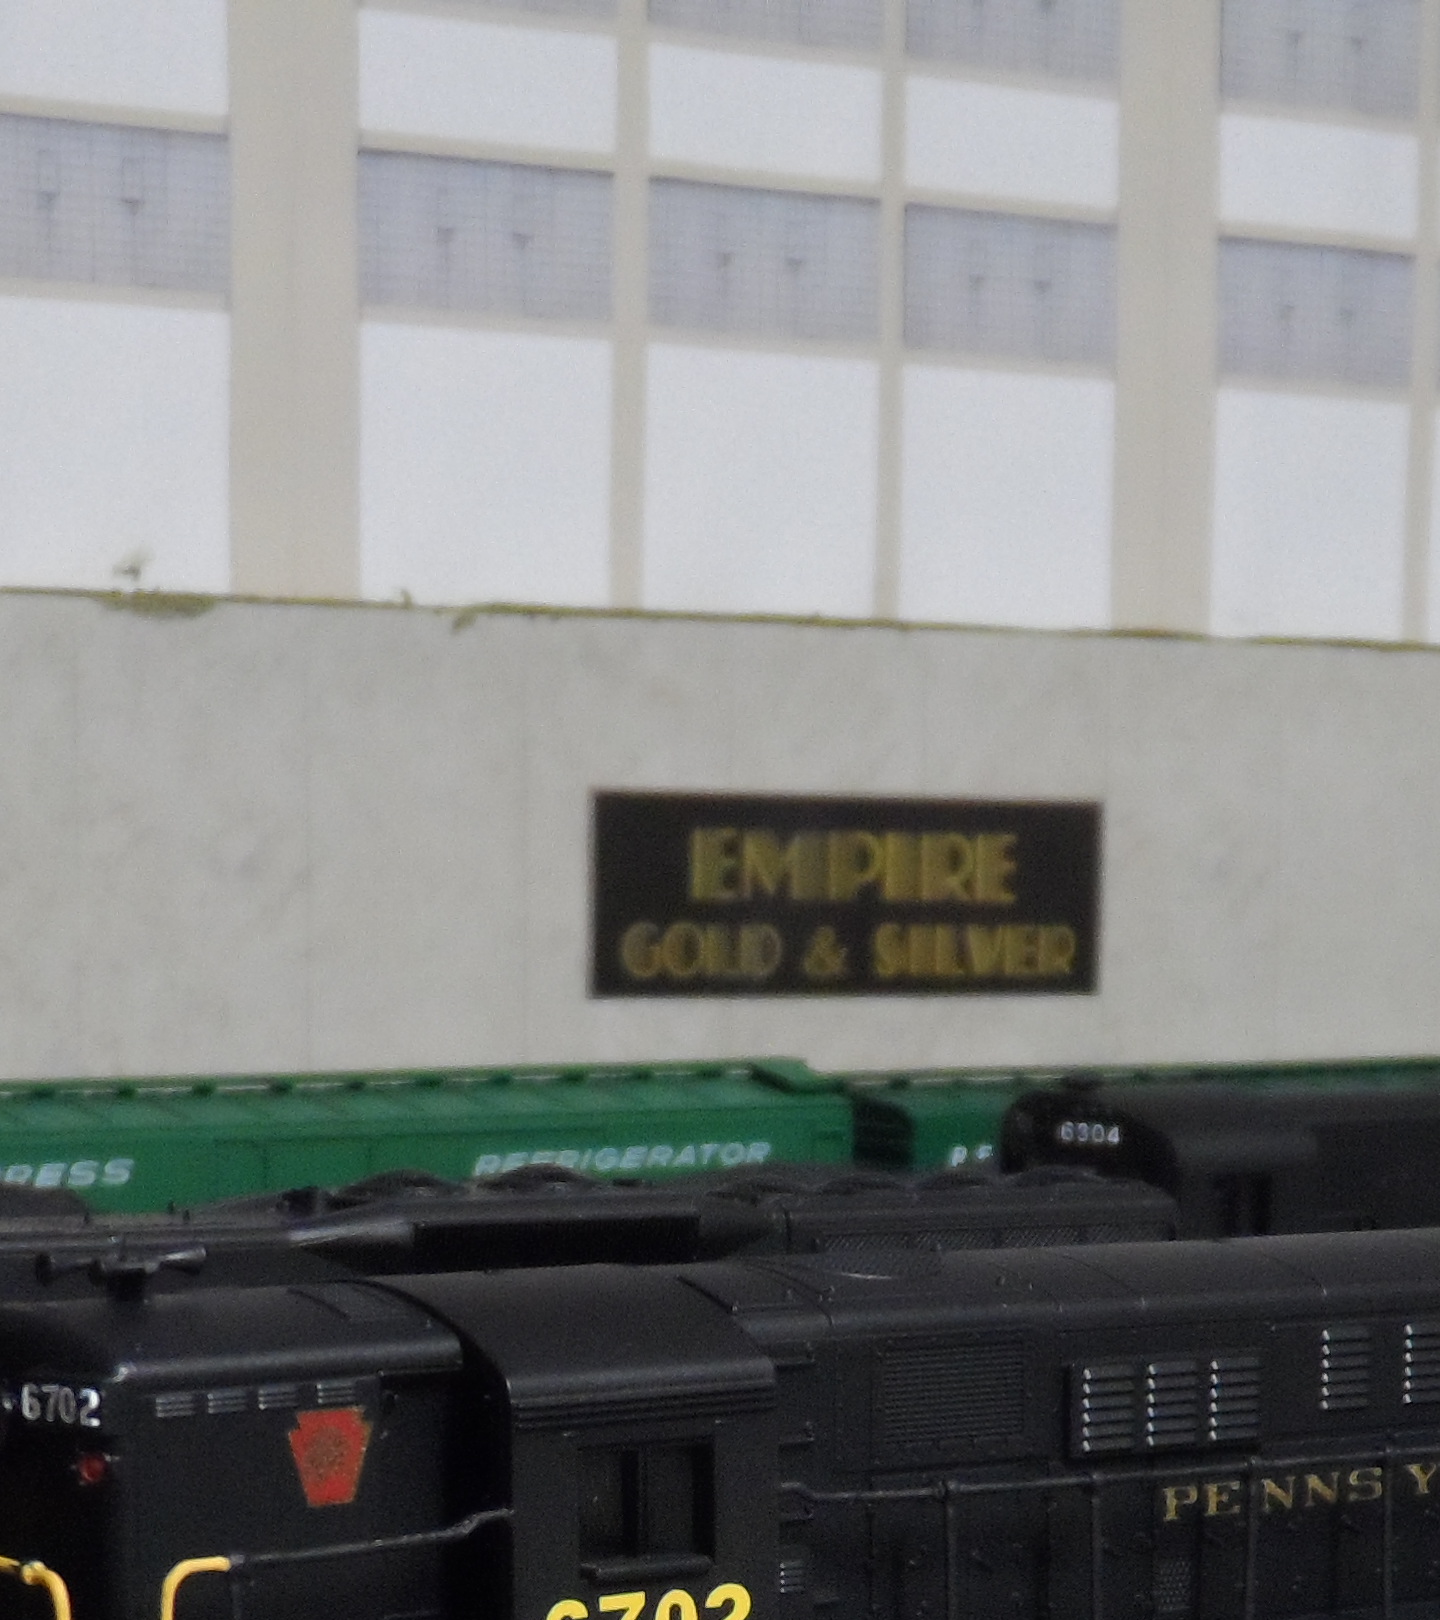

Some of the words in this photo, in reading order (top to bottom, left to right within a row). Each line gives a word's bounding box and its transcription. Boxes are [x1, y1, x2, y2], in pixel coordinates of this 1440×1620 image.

[689, 826, 1019, 905] EMPIRE
[620, 922, 782, 982] GOLD
[802, 925, 848, 980] &
[872, 922, 1078, 980] SILVER
[21, 1383, 101, 1428] 6702
